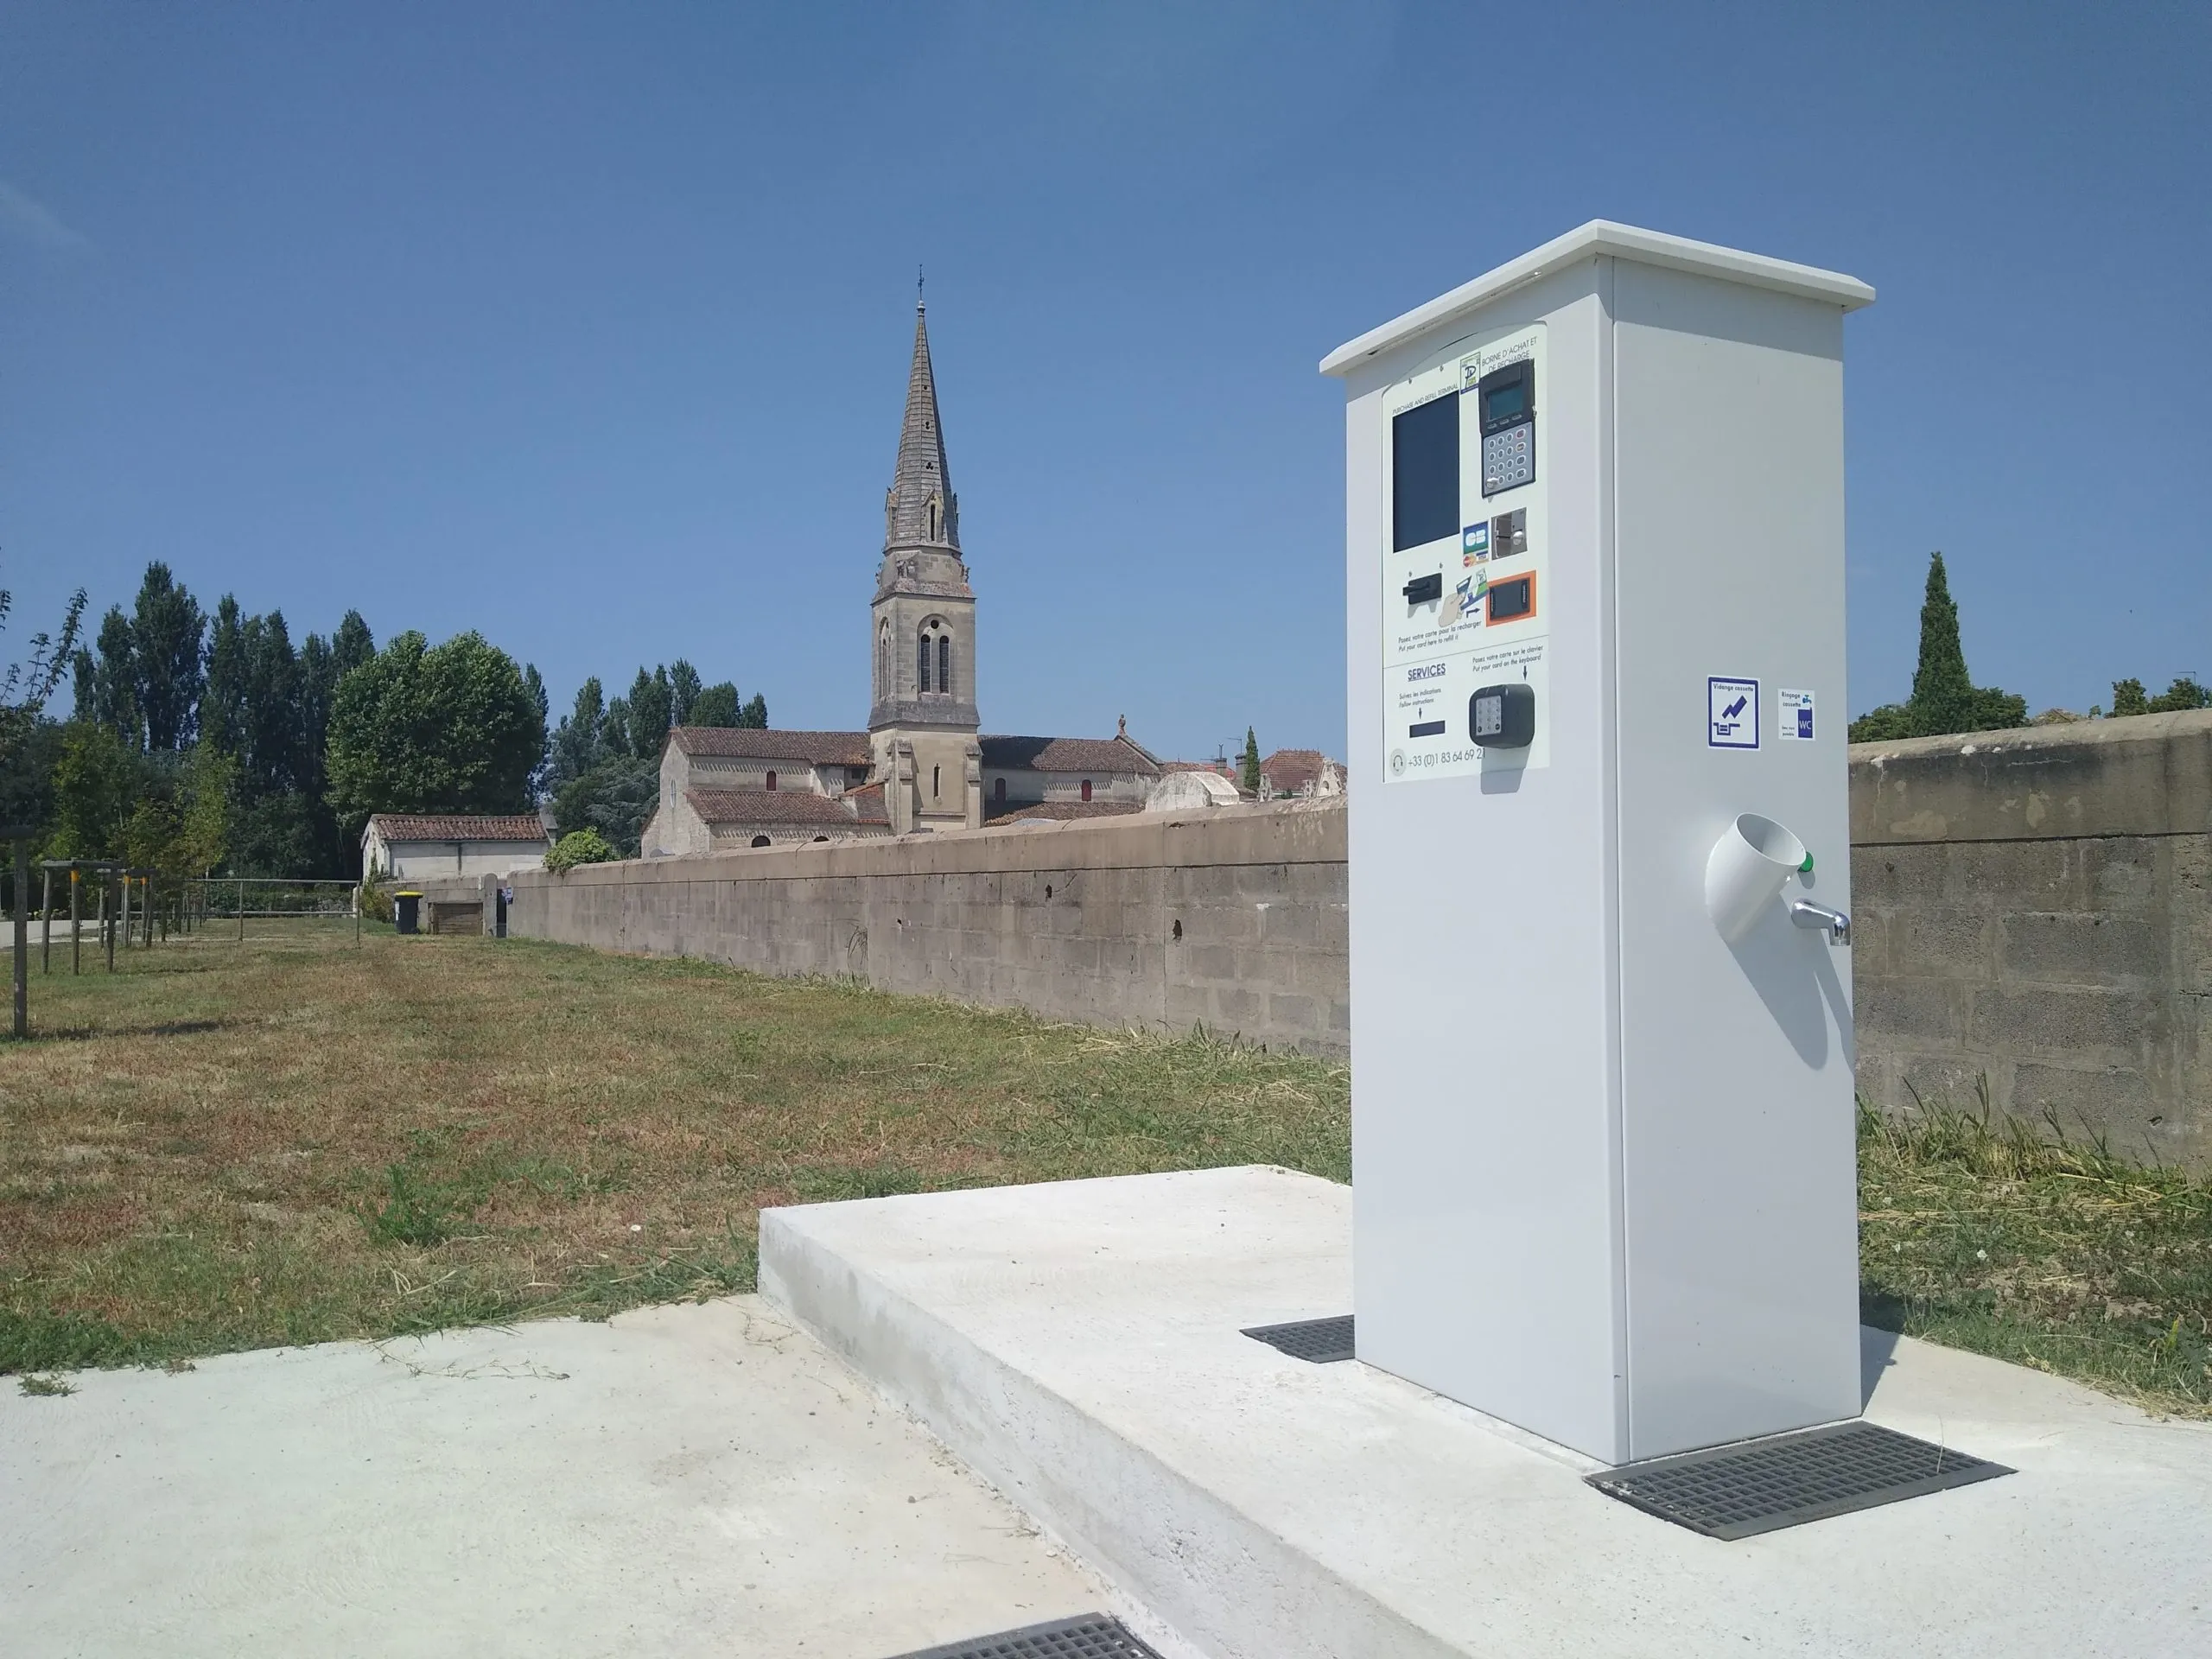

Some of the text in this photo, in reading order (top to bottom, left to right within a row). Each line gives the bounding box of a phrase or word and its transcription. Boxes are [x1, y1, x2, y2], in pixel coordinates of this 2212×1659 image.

[1482, 352, 1501, 366] BORNE
[1503, 340, 1529, 358] D'ACHAT
[1531, 336, 1537, 346] ET
[1392, 401, 1414, 415] PURCHASE
[1414, 397, 1424, 406] AND
[1438, 383, 1458, 395] TERMINAL
[1457, 621, 1482, 630] recharger
[1527, 644, 1543, 653] clavier
[1519, 653, 1541, 664] keyboard
[1408, 663, 1446, 680] SERVICES
[1799, 720, 1811, 729] WC
[1408, 748, 1485, 767] +33 (0)1 83 64 69 21
